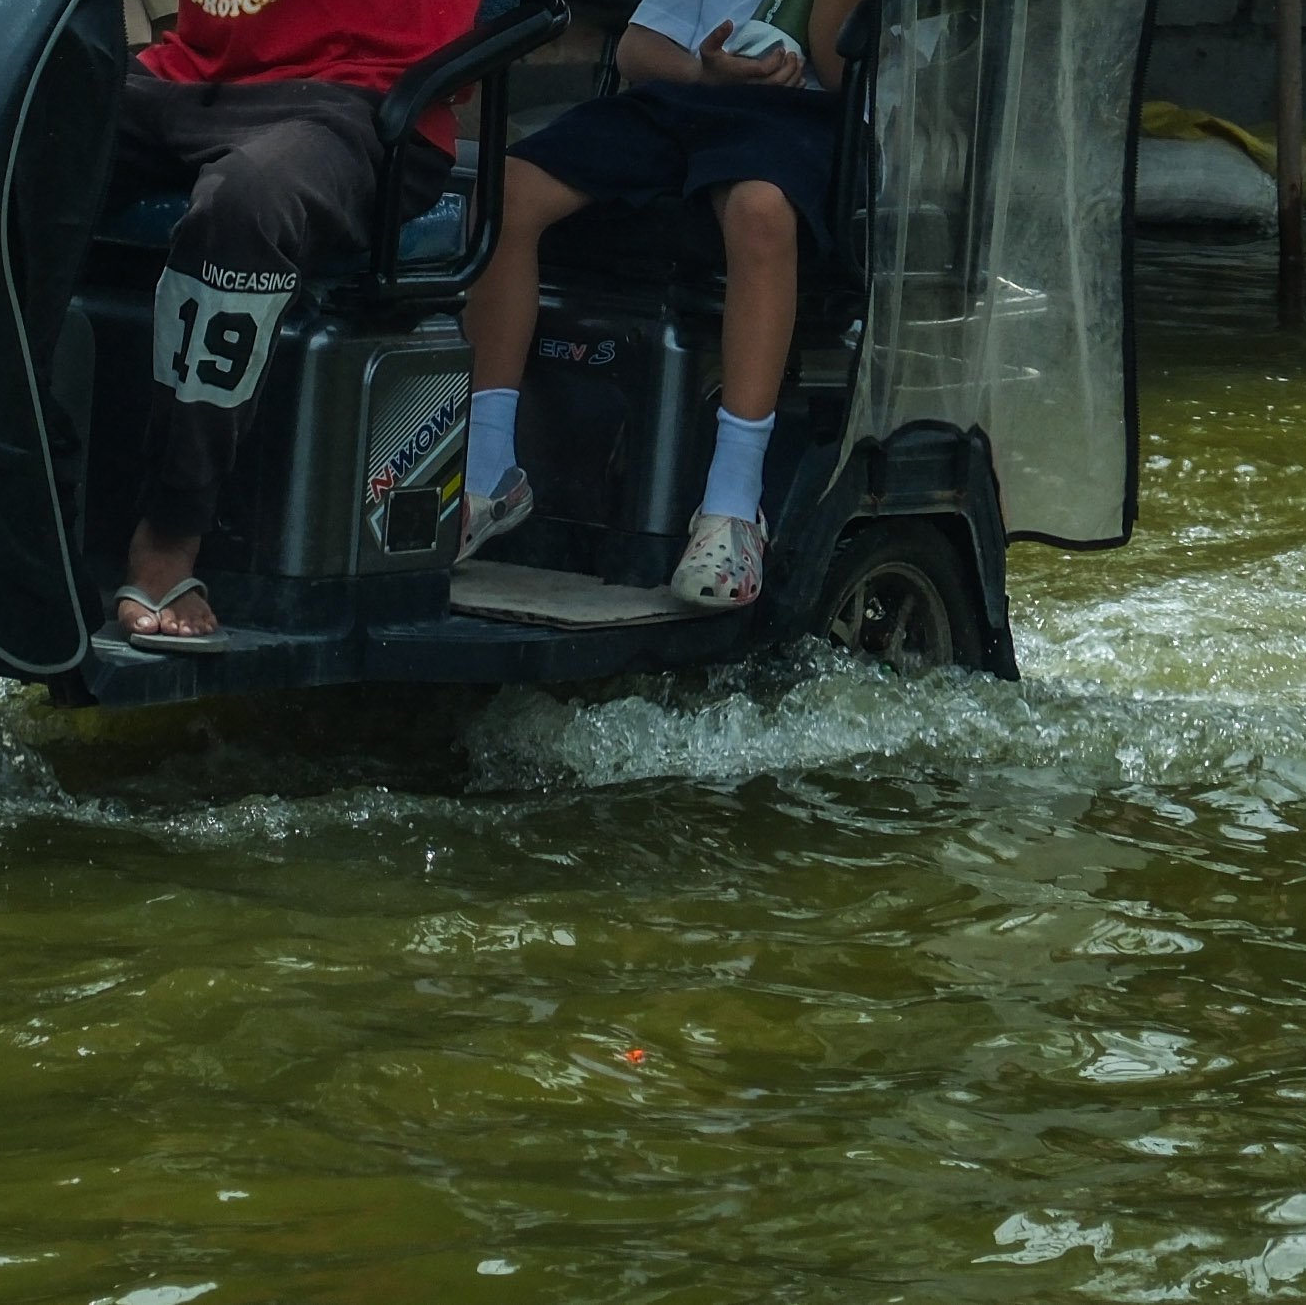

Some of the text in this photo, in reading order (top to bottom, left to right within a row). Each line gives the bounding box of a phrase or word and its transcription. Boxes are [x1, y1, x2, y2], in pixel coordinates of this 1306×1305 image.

[201, 259, 297, 292] UNCEASING
[171, 297, 258, 392] 19
[538, 337, 589, 362] ERV
[370, 393, 456, 505] NWOW
